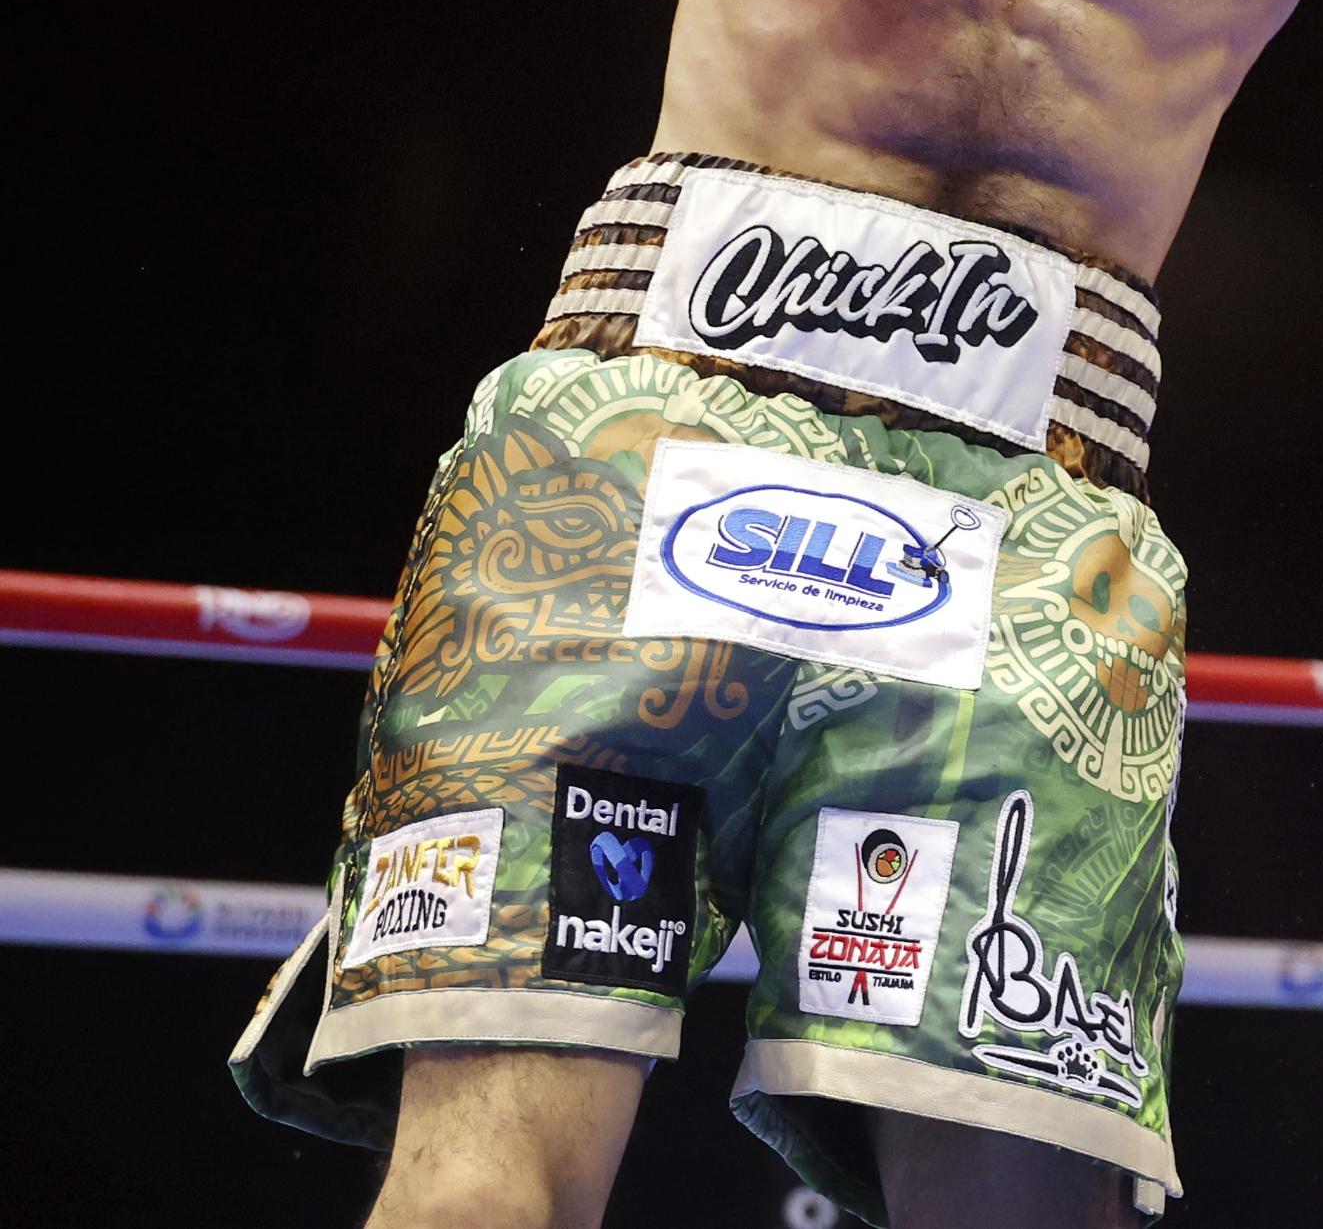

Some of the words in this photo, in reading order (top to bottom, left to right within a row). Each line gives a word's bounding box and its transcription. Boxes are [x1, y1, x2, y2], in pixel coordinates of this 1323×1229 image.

[707, 508, 895, 599] SILL
[738, 574, 797, 592] Servicio
[801, 582, 820, 597] de
[824, 589, 885, 613] limpieza
[565, 785, 680, 837] Dental
[362, 833, 482, 923] ZANFER
[372, 888, 448, 941] BOXING
[836, 909, 905, 935] SUSHI
[809, 932, 923, 970] ZONAJA
[808, 969, 842, 983] ESTILO
